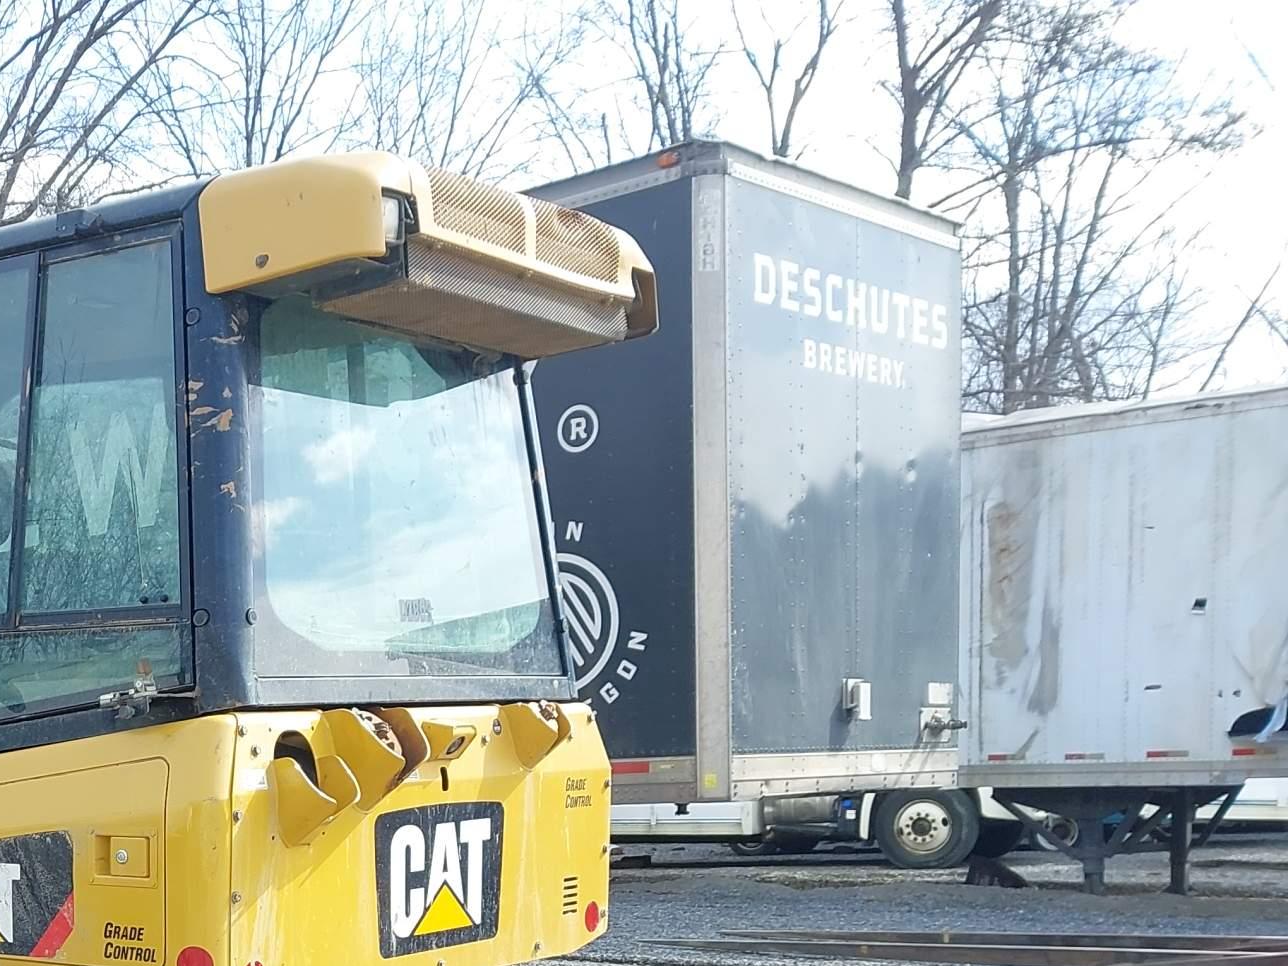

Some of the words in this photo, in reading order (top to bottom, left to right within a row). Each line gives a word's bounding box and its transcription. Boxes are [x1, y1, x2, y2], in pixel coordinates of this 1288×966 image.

[753, 252, 948, 350] DESCHUTES
[565, 777, 587, 792] GRADE
[565, 794, 592, 809] CONTROL
[390, 818, 491, 939] CAT
[104, 922, 144, 941] GRADE
[104, 942, 157, 963] CONTROL
